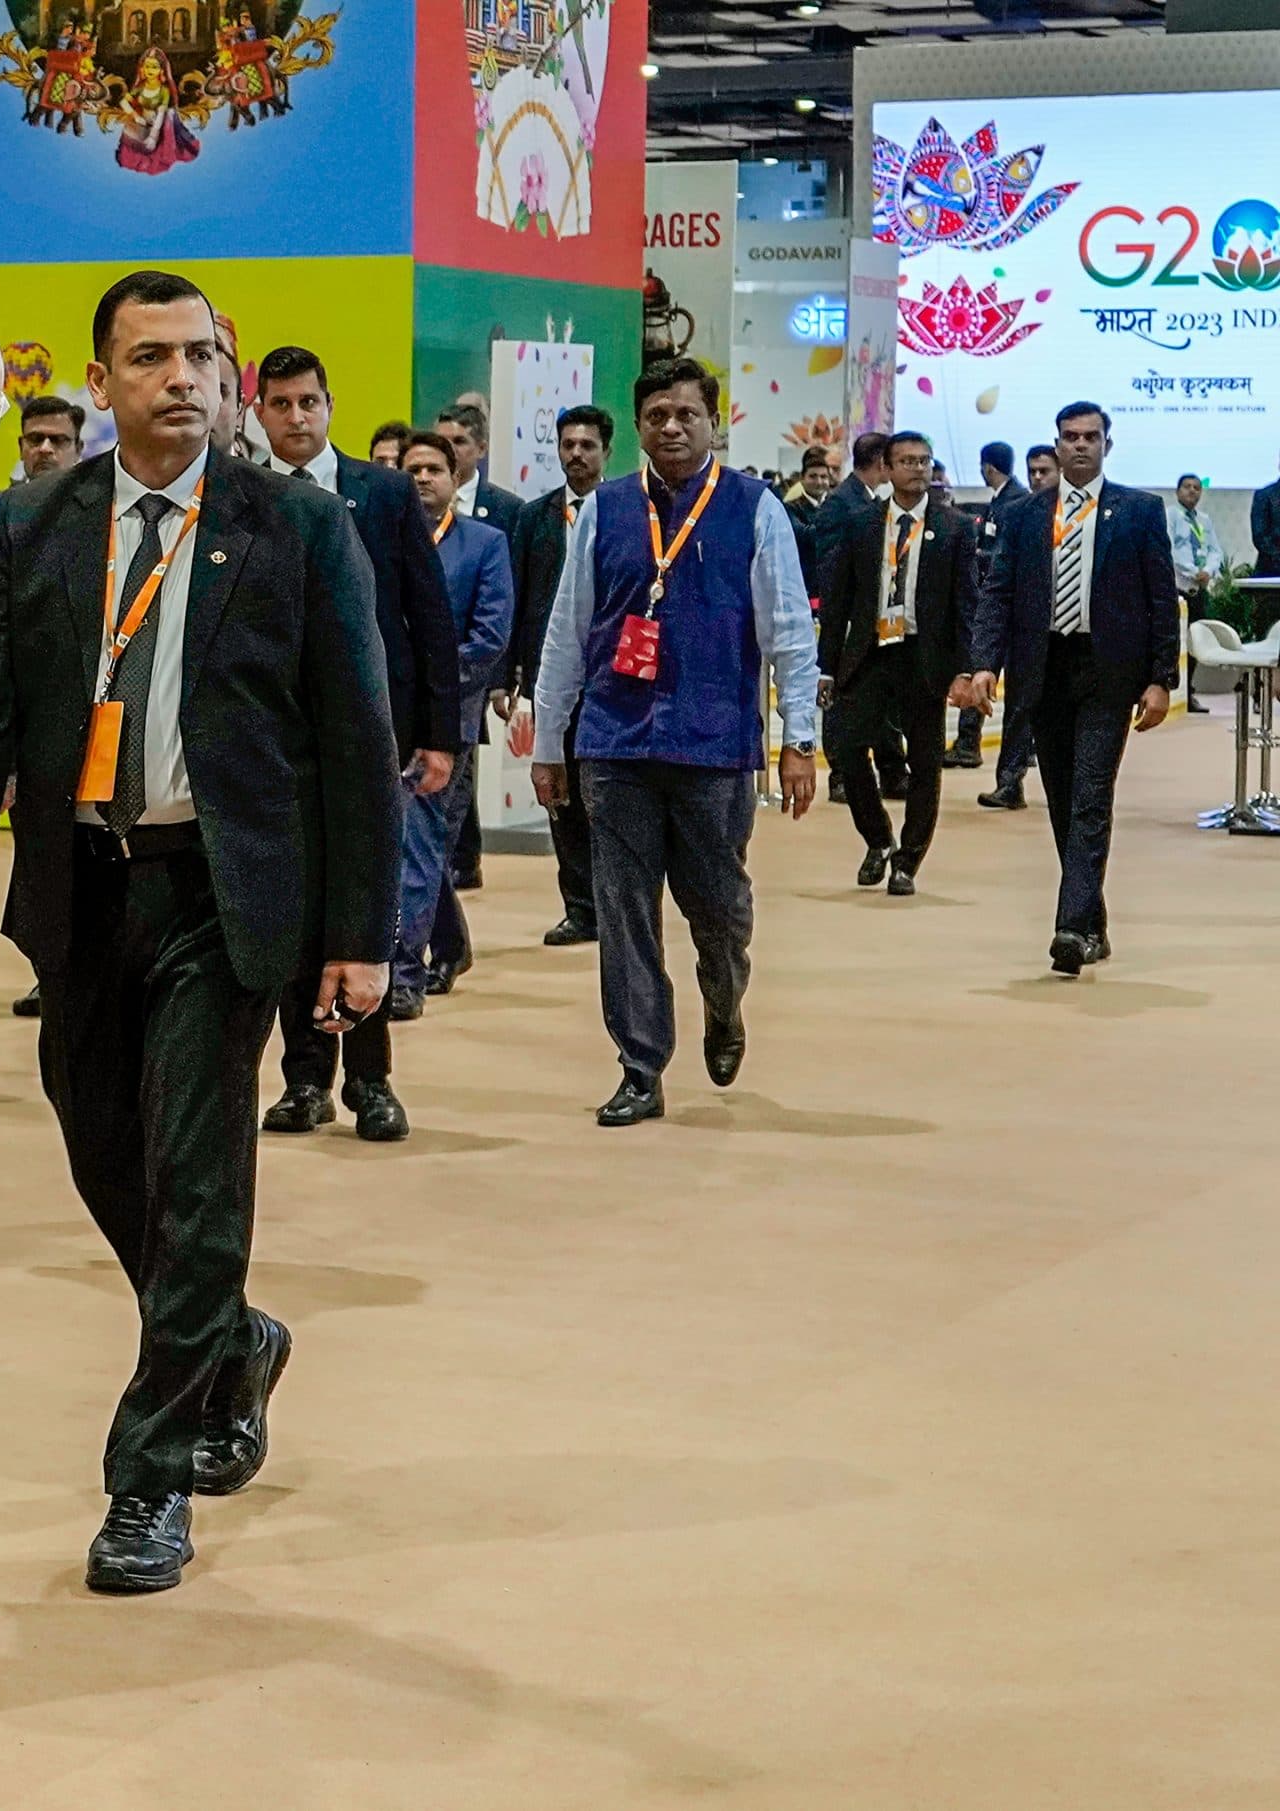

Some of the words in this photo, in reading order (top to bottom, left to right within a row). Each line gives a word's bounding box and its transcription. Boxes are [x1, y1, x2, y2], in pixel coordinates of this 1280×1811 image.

[748, 246, 841, 261] GODAVARI
[1080, 308, 1165, 345] भारत
[1166, 313, 1223, 337] 2023
[1233, 309, 1280, 328] IND
